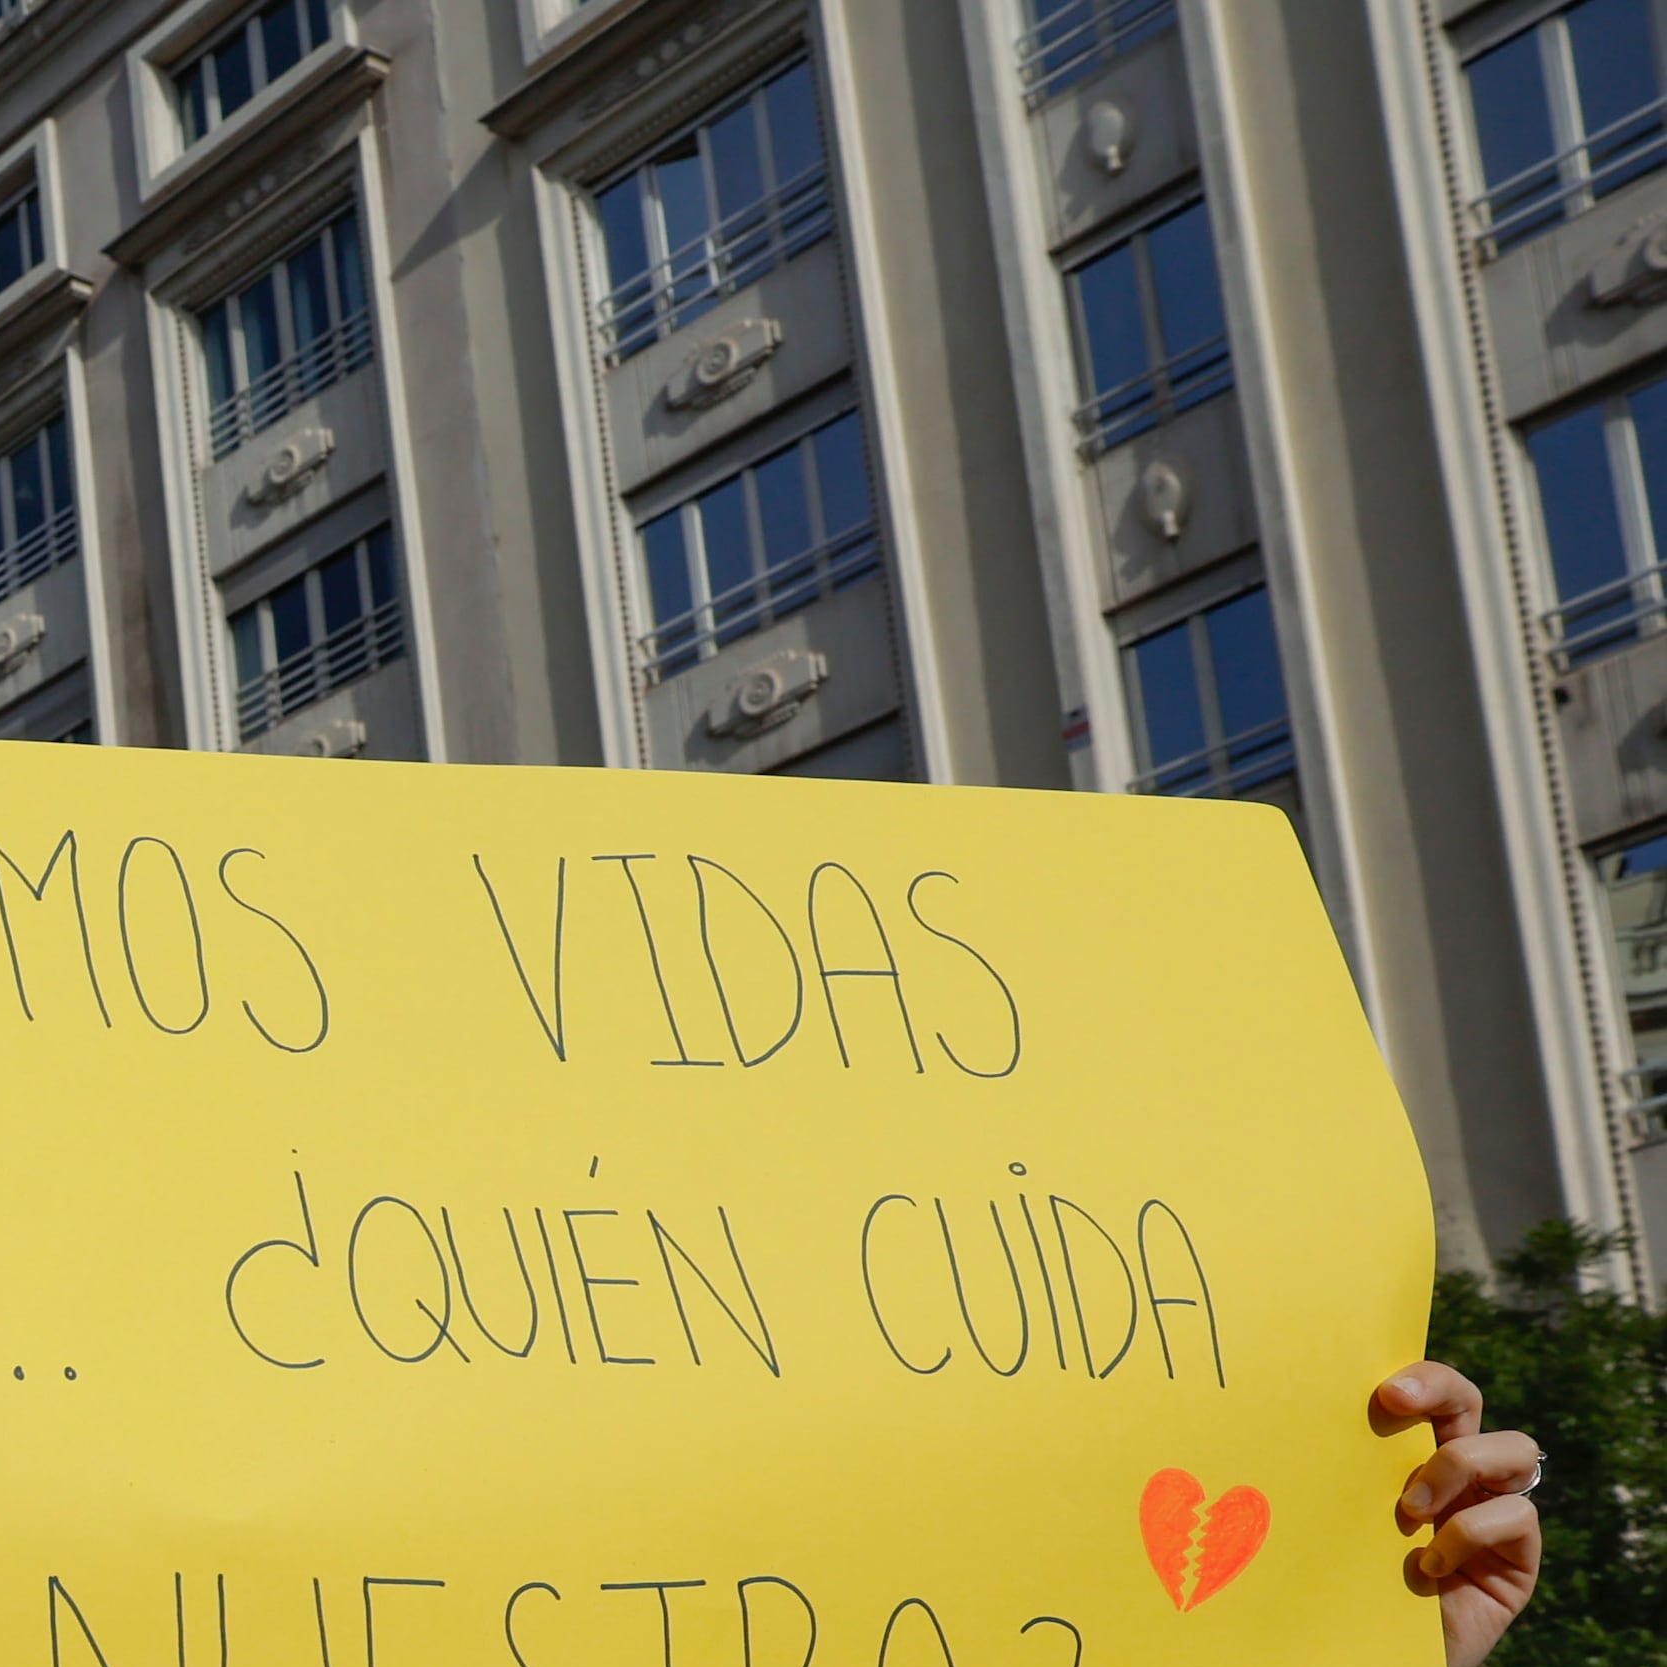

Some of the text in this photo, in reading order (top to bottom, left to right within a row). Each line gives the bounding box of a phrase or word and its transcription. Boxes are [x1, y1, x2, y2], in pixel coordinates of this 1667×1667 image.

[471, 853, 1022, 1079] VIDAS
[224, 1148, 781, 1379] ¿QUIÉN
[861, 1160, 1227, 1390] CUIDA
